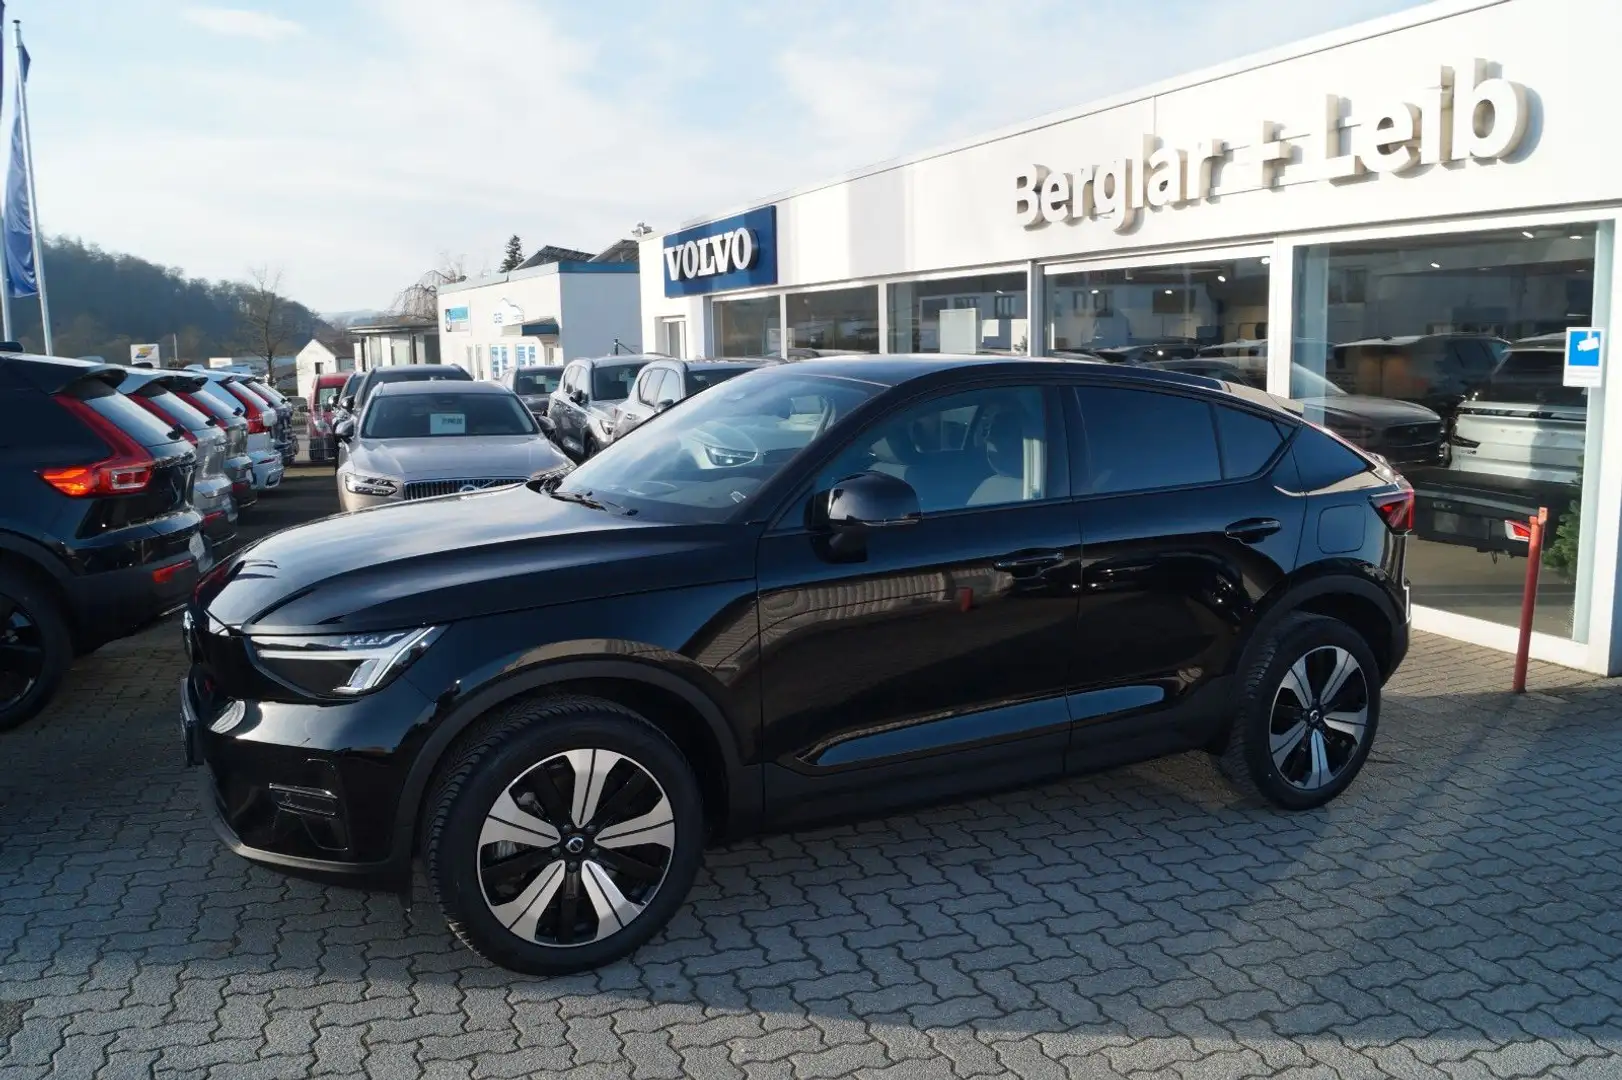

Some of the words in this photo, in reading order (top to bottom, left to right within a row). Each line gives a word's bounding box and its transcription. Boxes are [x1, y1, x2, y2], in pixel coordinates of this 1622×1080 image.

[1013, 134, 1226, 234] Berglar
[1237, 121, 1289, 189] +
[1308, 57, 1530, 184] Leib
[664, 227, 754, 282] VOLVO
